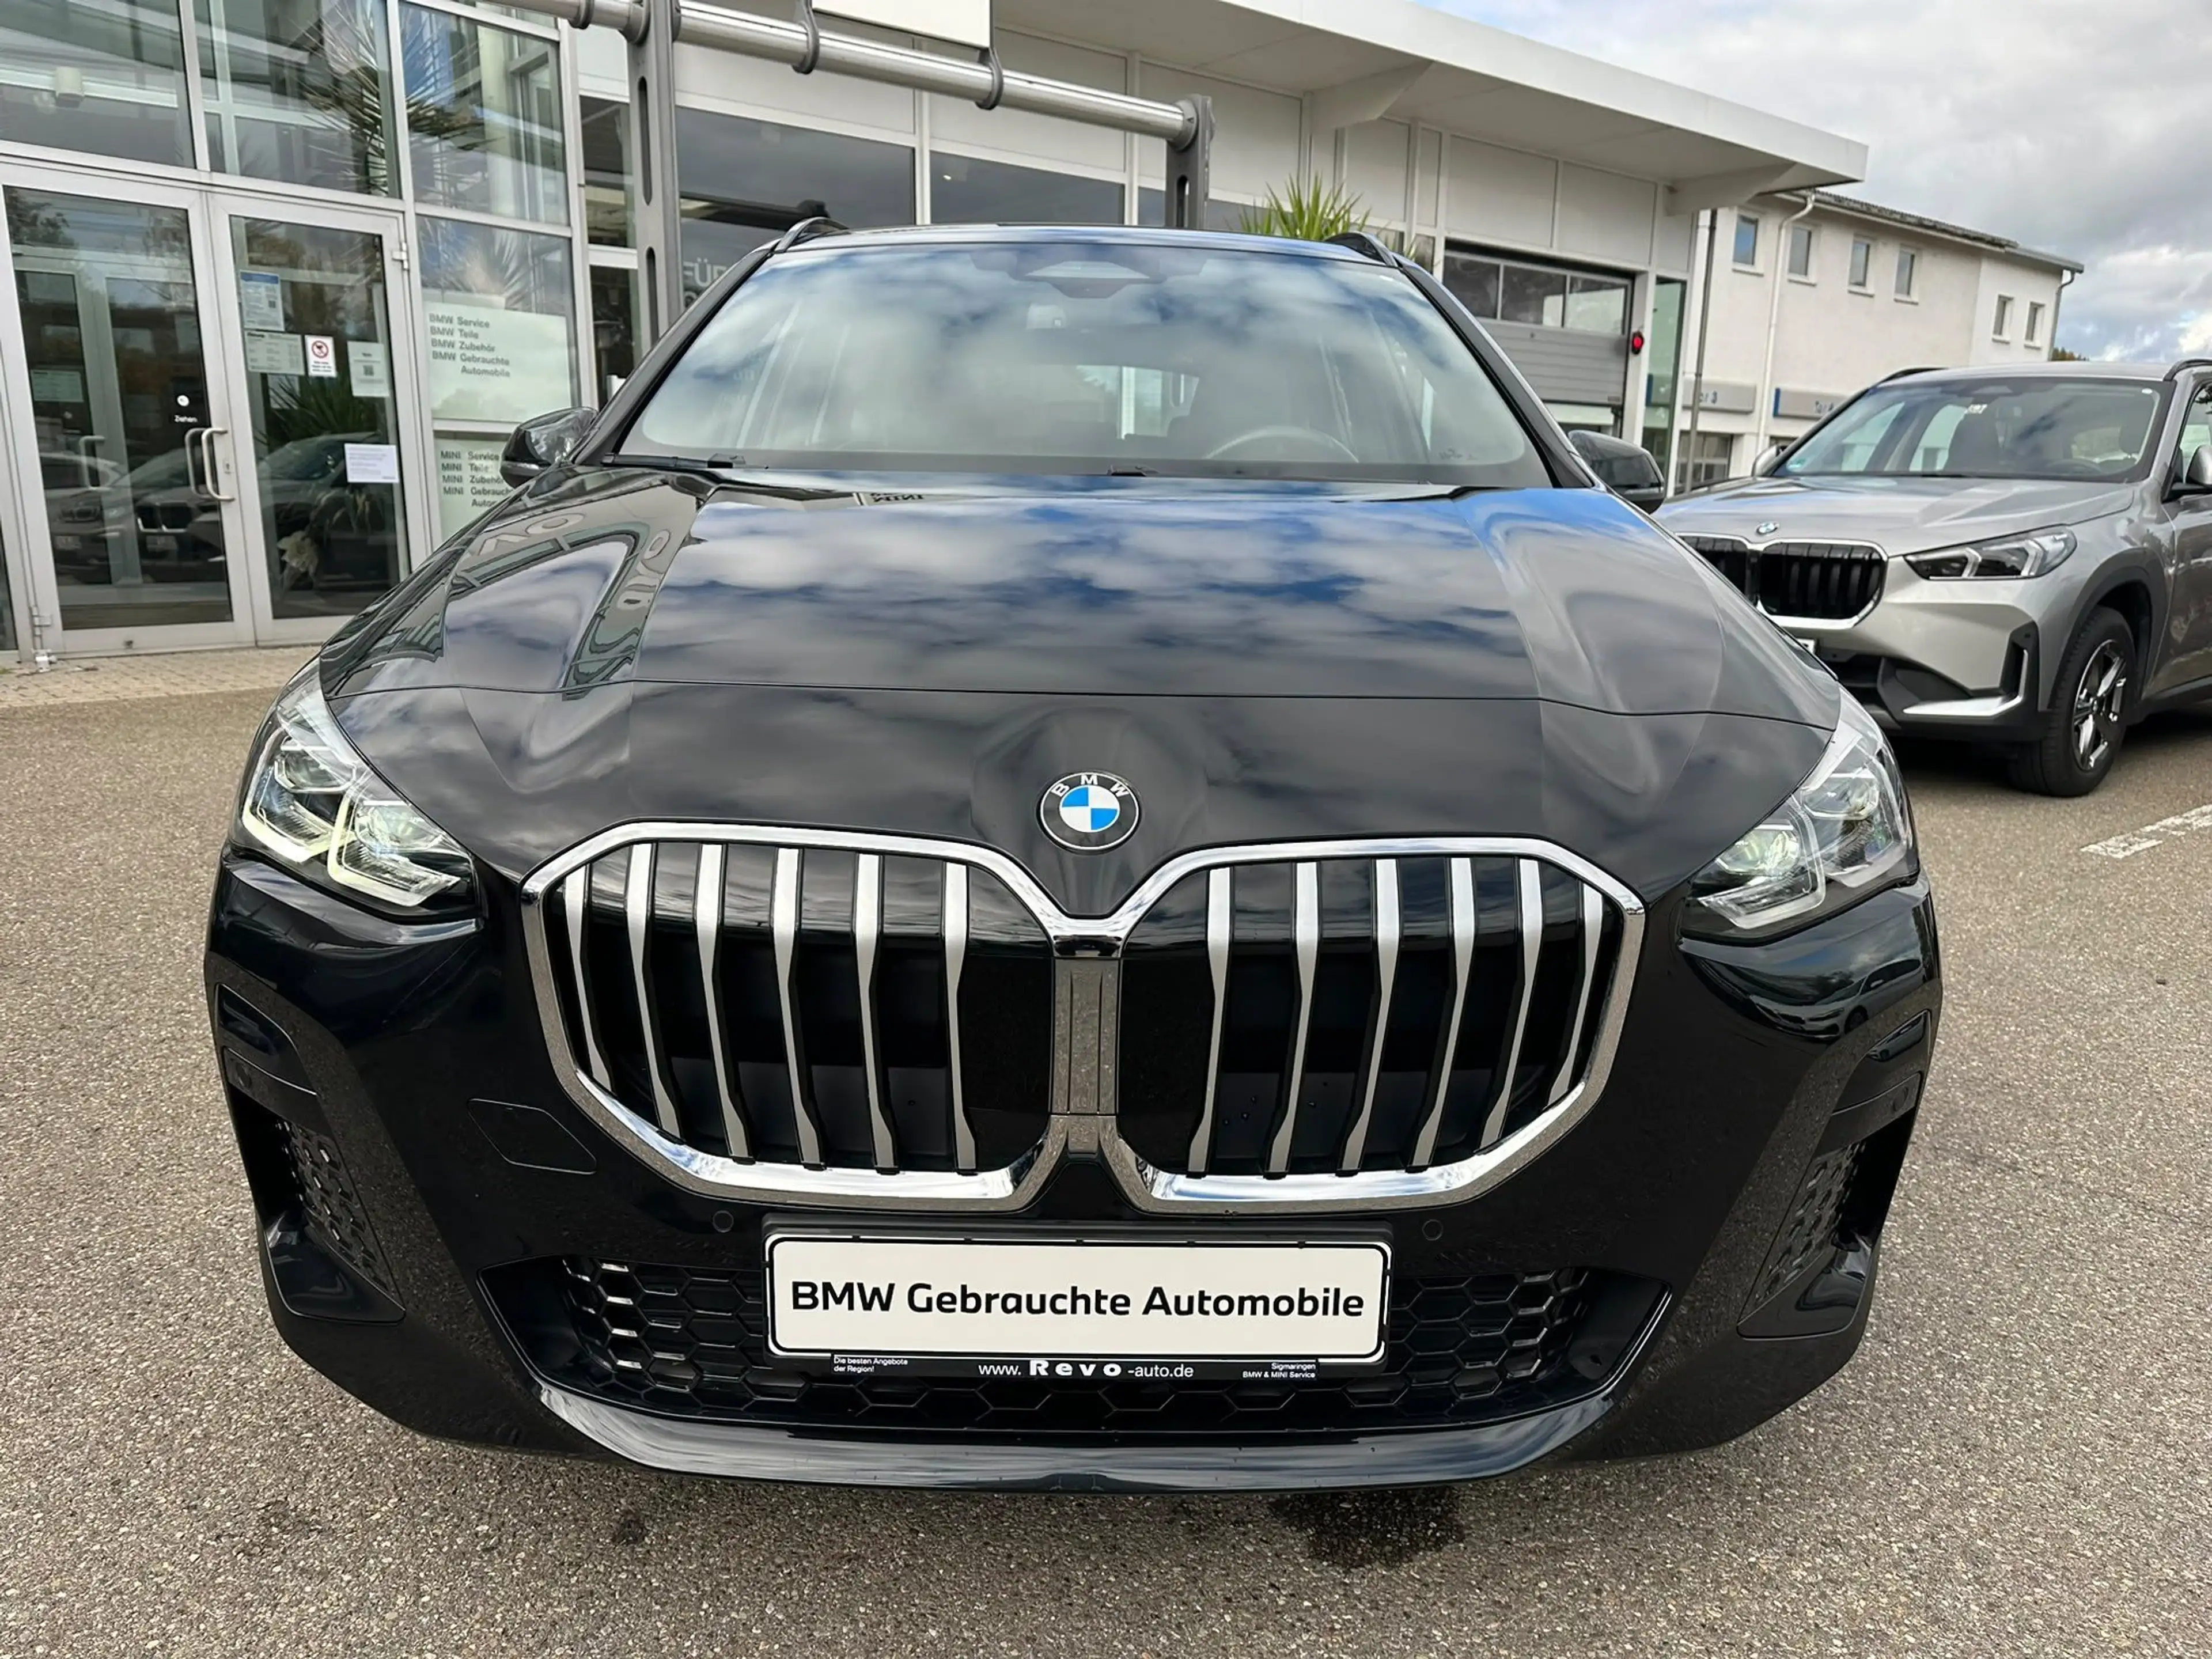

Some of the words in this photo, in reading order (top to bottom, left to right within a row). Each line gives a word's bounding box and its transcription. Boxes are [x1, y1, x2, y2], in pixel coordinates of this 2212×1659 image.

[429, 313, 454, 324] BMW
[456, 316, 490, 328] Service
[430, 325, 454, 336] BMW
[457, 328, 479, 339] Teile
[431, 338, 456, 349] BMW
[459, 340, 495, 352] Zubehör
[432, 350, 456, 361] BMW
[460, 352, 510, 366] Gebrauchte
[461, 365, 510, 377] Automobile
[441, 450, 461, 460] MINI
[468, 451, 500, 461] Service
[441, 463, 462, 472] MINI
[442, 475, 463, 484] MINI
[443, 487, 464, 495] MINI
[470, 487, 512, 496] Gebrauch
[1051, 774, 1130, 797] BMW
[791, 1281, 895, 1312] BMW
[907, 1283, 1131, 1316] Gebrauchte
[1142, 1286, 1365, 1317] Automobile
[873, 1358, 908, 1366] Angebote
[1271, 1362, 1316, 1371] Sigmaringen
[847, 1365, 875, 1374] Region!
[978, 1365, 1021, 1376] www.
[1029, 1359, 1122, 1376] Revo
[1127, 1363, 1194, 1378] -auto.de
